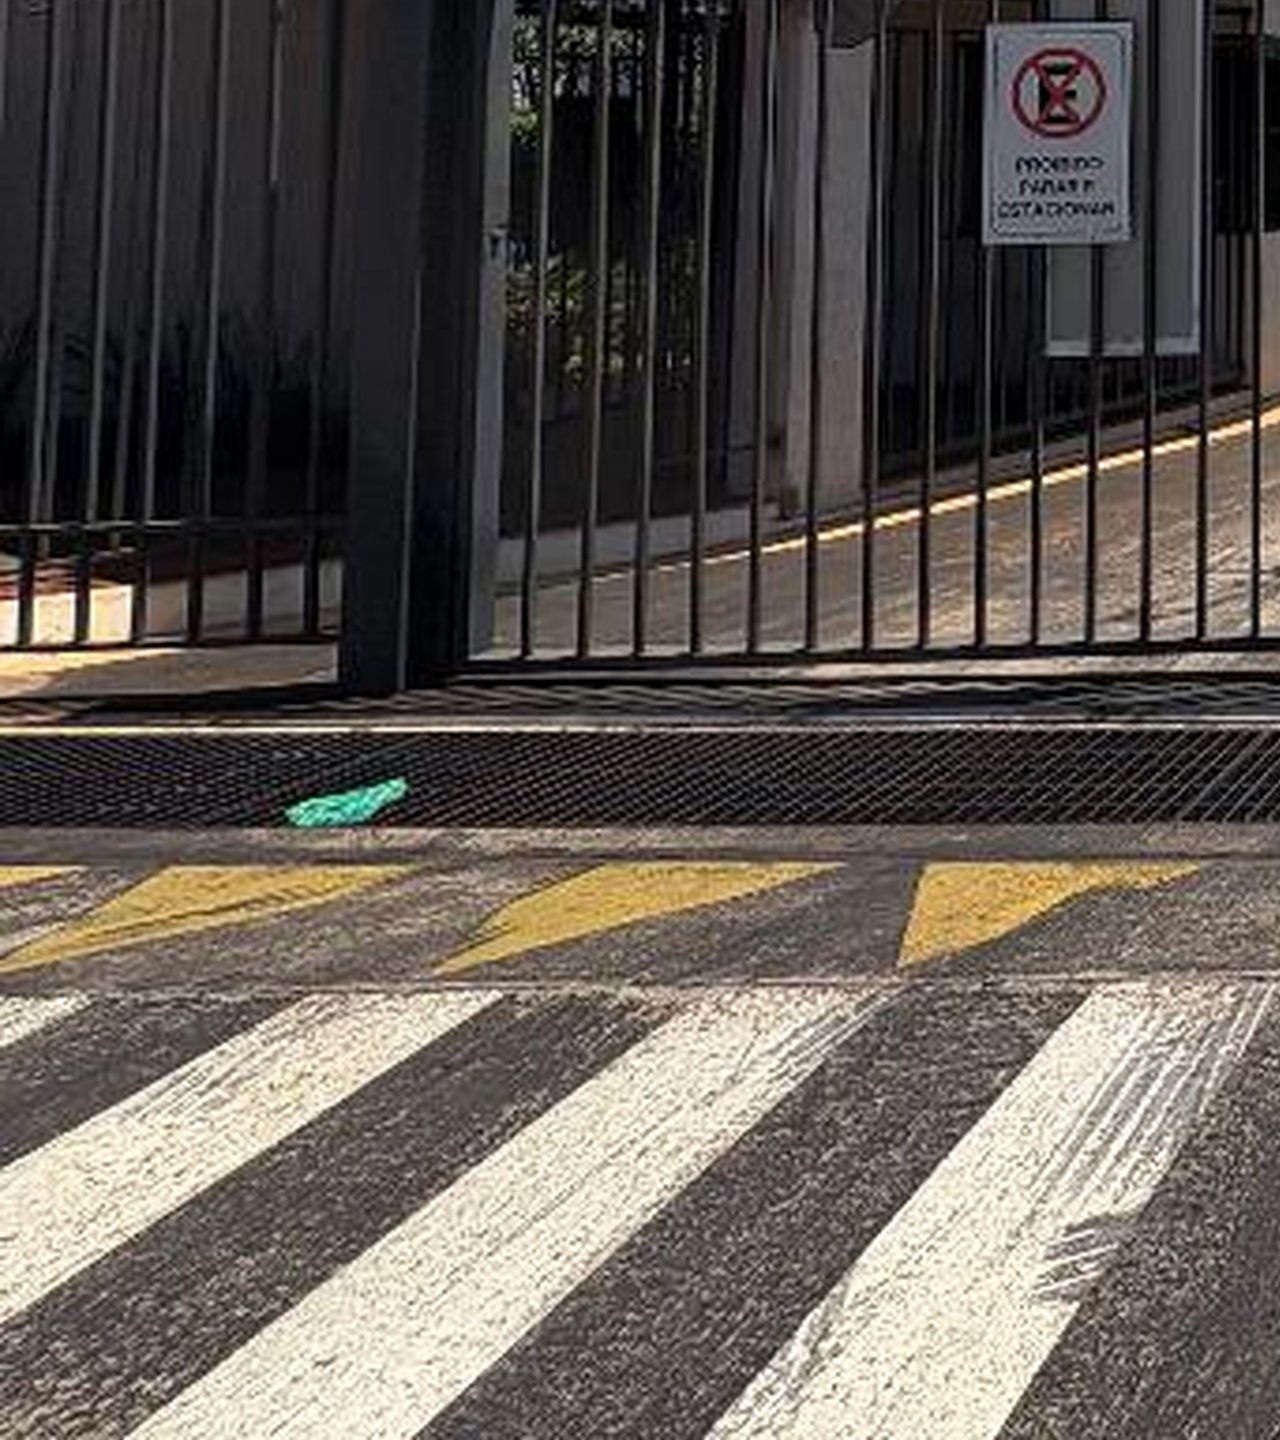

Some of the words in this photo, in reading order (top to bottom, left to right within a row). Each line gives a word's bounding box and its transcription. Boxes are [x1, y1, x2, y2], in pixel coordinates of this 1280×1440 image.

[1015, 156, 1105, 173] PROIBIDO
[1019, 178, 1078, 196] PARAR
[1083, 179, 1095, 194] E
[998, 201, 1114, 219] ESTACIONAR
